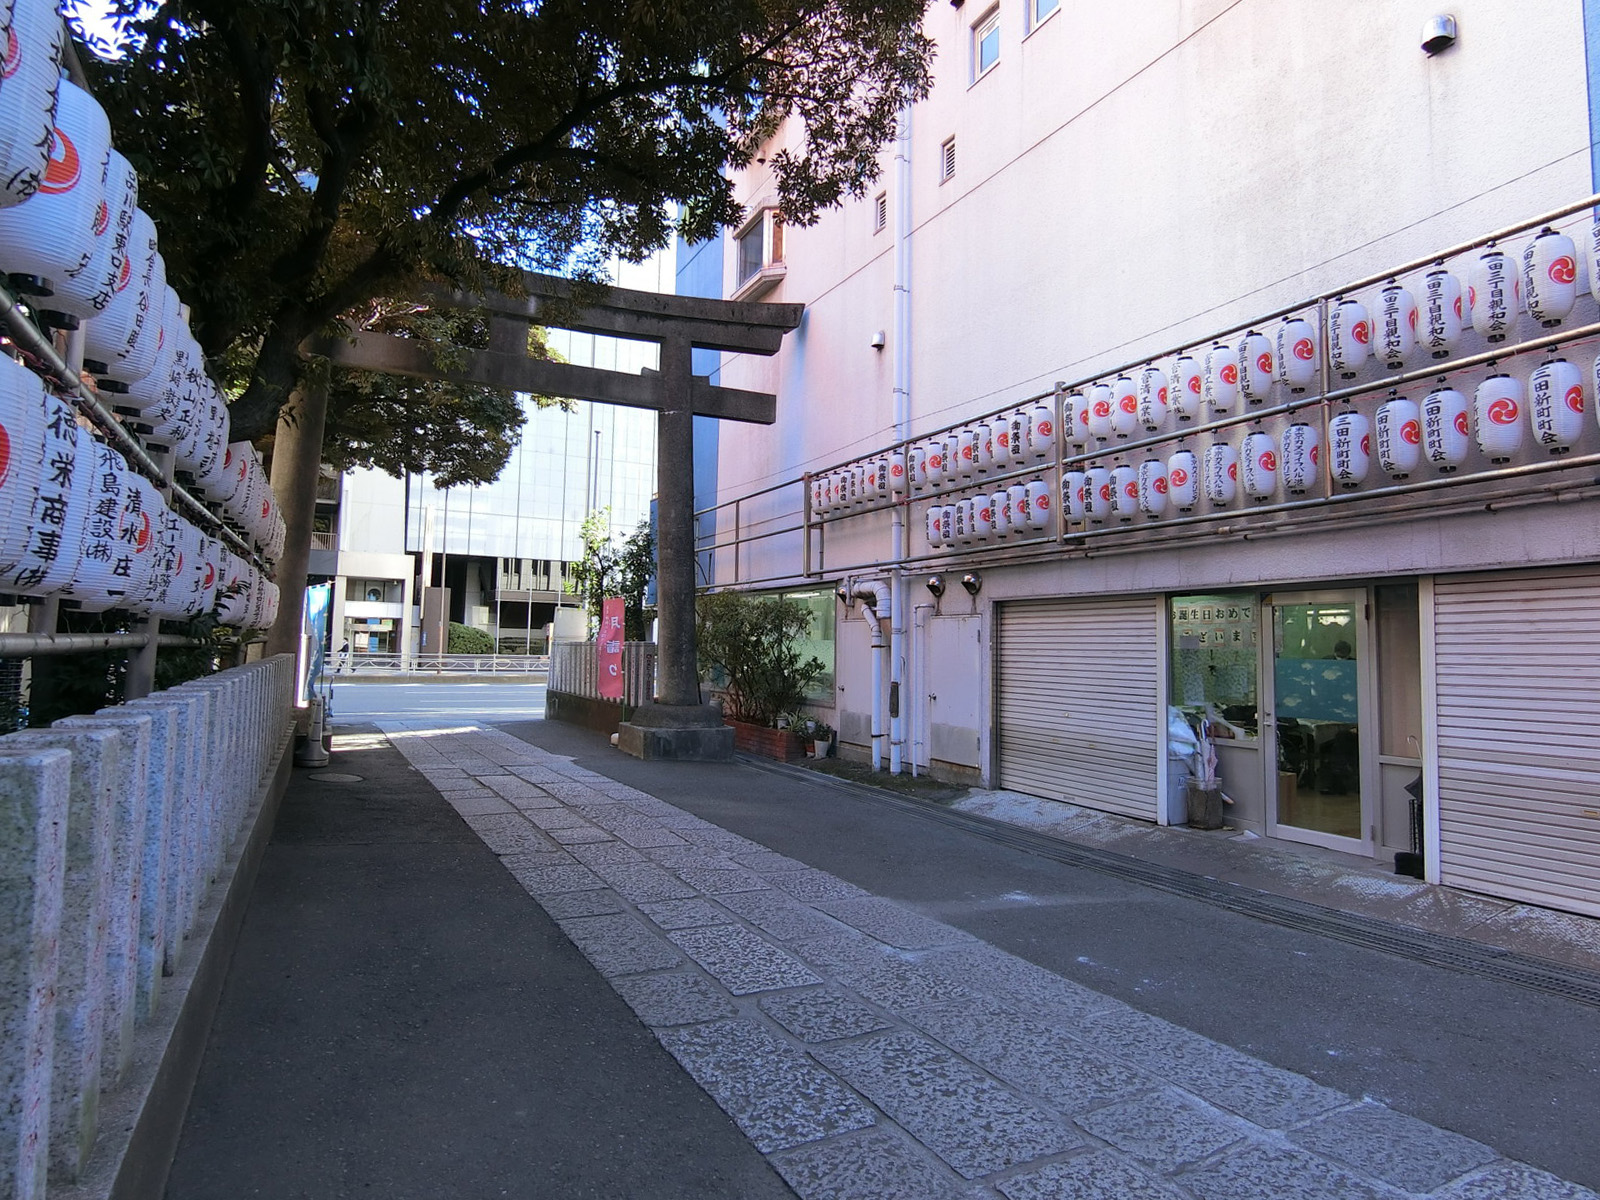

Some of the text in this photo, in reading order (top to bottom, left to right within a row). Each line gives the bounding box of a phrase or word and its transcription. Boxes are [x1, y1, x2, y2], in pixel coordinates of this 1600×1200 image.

[1384, 291, 1401, 359] 三田三丁目親和会
[1427, 277, 1446, 348] 三田三丁目親和会
[1487, 258, 1507, 331] 三田三丁目親和会
[1377, 403, 1395, 471] 三田新町町会
[1424, 394, 1447, 461] 三田新町町会
[1533, 366, 1557, 445] 三田新町町会
[1336, 416, 1353, 480] 三田新町町会
[86, 450, 124, 563] 飛島建設(株)
[107, 487, 143, 596] 清水庄一
